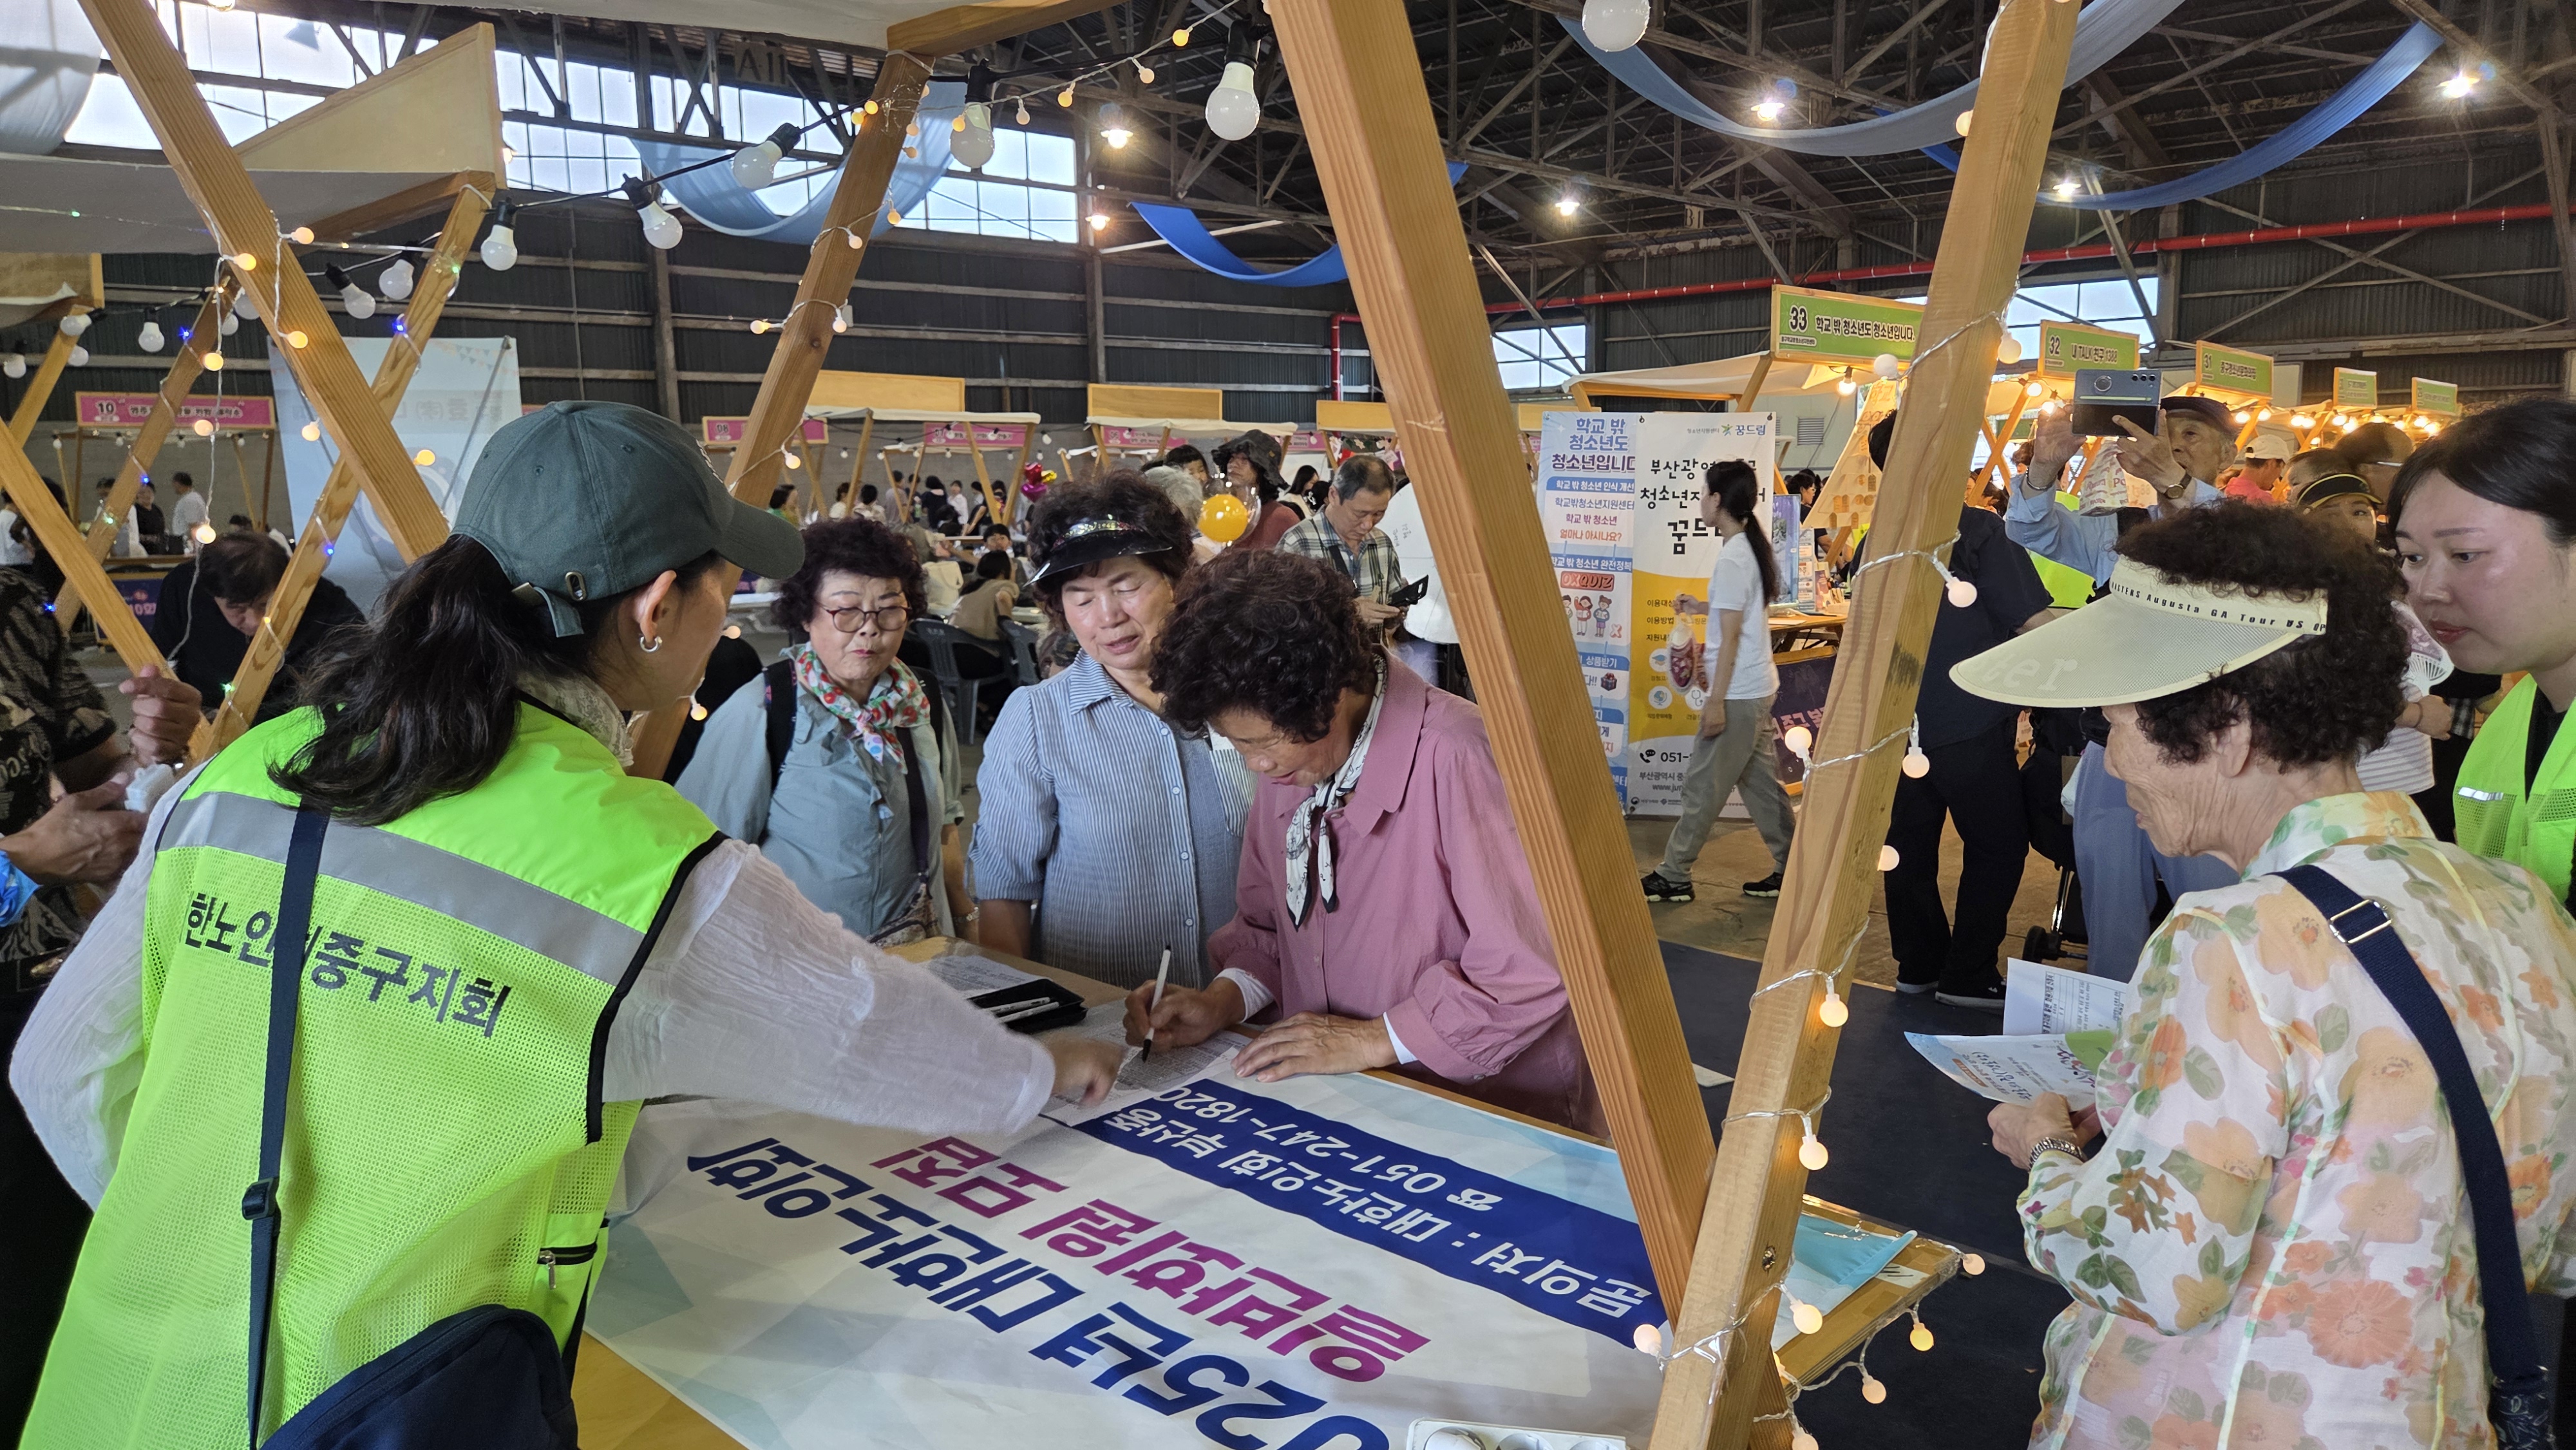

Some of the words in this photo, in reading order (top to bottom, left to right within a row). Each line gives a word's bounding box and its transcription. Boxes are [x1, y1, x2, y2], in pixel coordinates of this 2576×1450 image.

[1790, 306, 1808, 331] 33
[1815, 315, 1832, 332] 학교
[1833, 317, 1842, 335] 밖
[1842, 319, 1871, 337] 청소년도
[1873, 323, 1915, 341] 청소년입니다.
[2049, 336, 2061, 355] 32
[2204, 353, 2212, 369] 31
[97, 402, 115, 413] 10
[716, 424, 730, 433] 08
[1577, 418, 1605, 435] 학교
[1610, 419, 1626, 435] 밖
[1735, 424, 1766, 436] 꿈드림
[1569, 434, 1629, 451] 청소년도
[1556, 480, 1571, 490] 학교
[1572, 481, 1580, 490] 밖
[1580, 481, 1602, 491] 청소년
[1603, 482, 1618, 492] 인식
[1619, 482, 1634, 493] 개선
[1555, 497, 1635, 511] 학교밖청소년지원센터
[1566, 513, 1582, 524] 학교
[1583, 514, 1592, 525] 밖
[1593, 515, 1618, 527] 청소년
[1560, 529, 1584, 540] 얼마나
[1585, 530, 1623, 542] 아시나요?
[1566, 558, 1575, 568] 밖
[1575, 558, 1600, 569] 청소년
[1600, 559, 1632, 572] 완전정복
[1562, 572, 1613, 588] OXQUIZ
[2146, 592, 2200, 615] Augusta
[2211, 608, 2228, 619] GA
[2240, 613, 2276, 626] Tour
[1646, 634, 1671, 642] 지원내
[1660, 751, 1692, 763] 051-
[184, 892, 512, 1038] 한노인중구지회
[1103, 1108, 1228, 1158] 부산중
[1154, 1084, 1448, 1195] 051-247-1820
[1216, 1149, 1453, 1244] 대한노인회
[688, 1137, 1086, 1334] 대한노인회
[1471, 1240, 1653, 1320] 문의처
[1018, 1198, 1431, 1383] 일반회원
